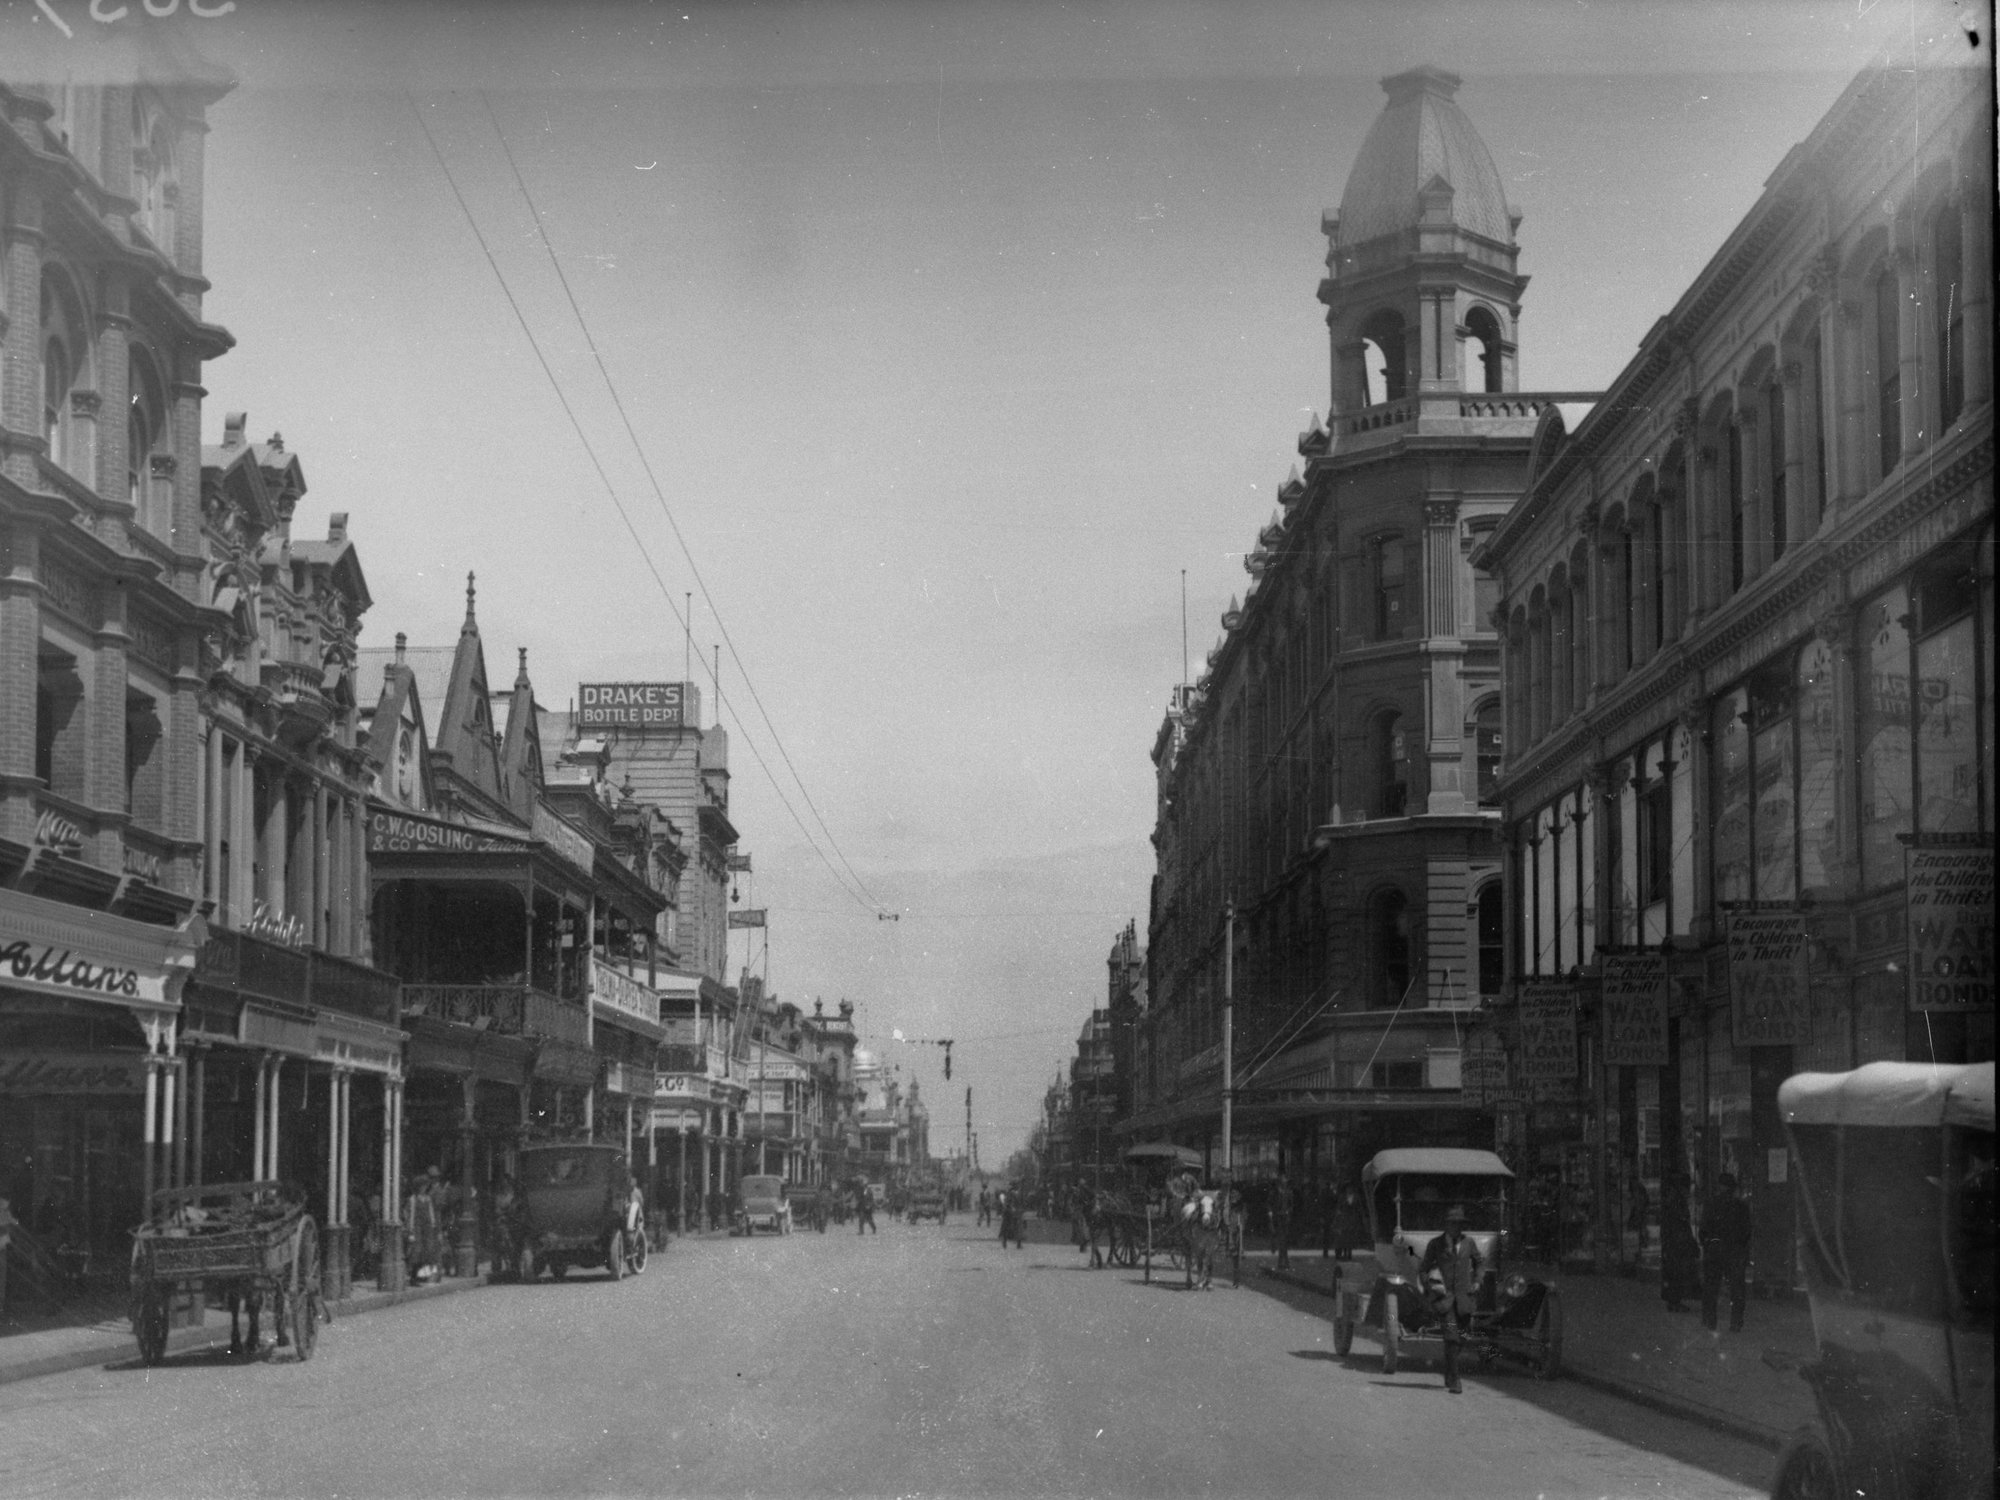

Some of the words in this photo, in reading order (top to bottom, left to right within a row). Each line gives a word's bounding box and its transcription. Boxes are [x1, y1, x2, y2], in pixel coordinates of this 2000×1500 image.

[584, 687, 679, 704] DRAKE'S
[584, 708, 639, 722] BOTTLE
[643, 708, 679, 722] DEPT
[372, 834, 384, 851] &
[1911, 889, 1928, 905] in
[1748, 931, 1804, 945] Children
[1733, 946, 1748, 961] in
